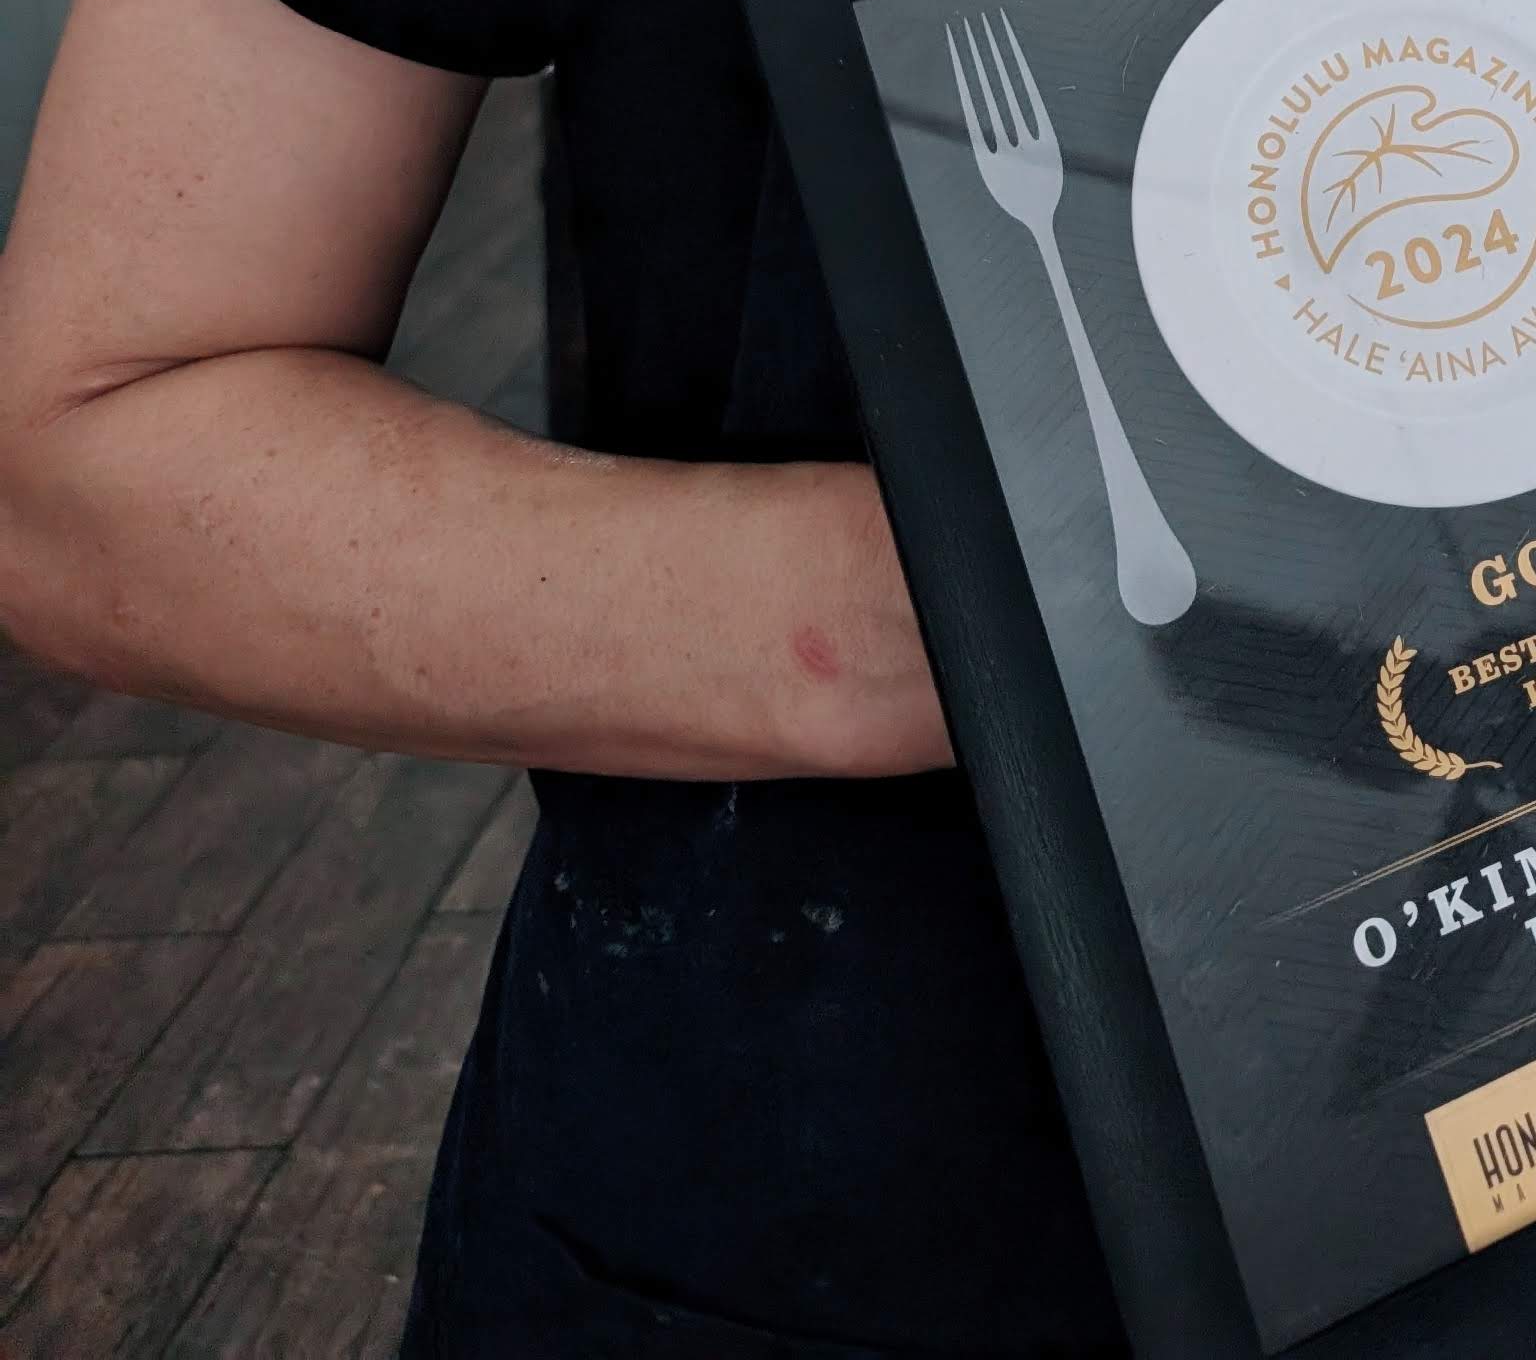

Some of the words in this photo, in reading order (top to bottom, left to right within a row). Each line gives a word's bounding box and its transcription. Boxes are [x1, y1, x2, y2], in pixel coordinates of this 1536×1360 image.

[1247, 52, 1350, 260] HONOLULU
[1364, 208, 1520, 301] 2024
[1292, 297, 1391, 376] HALE
